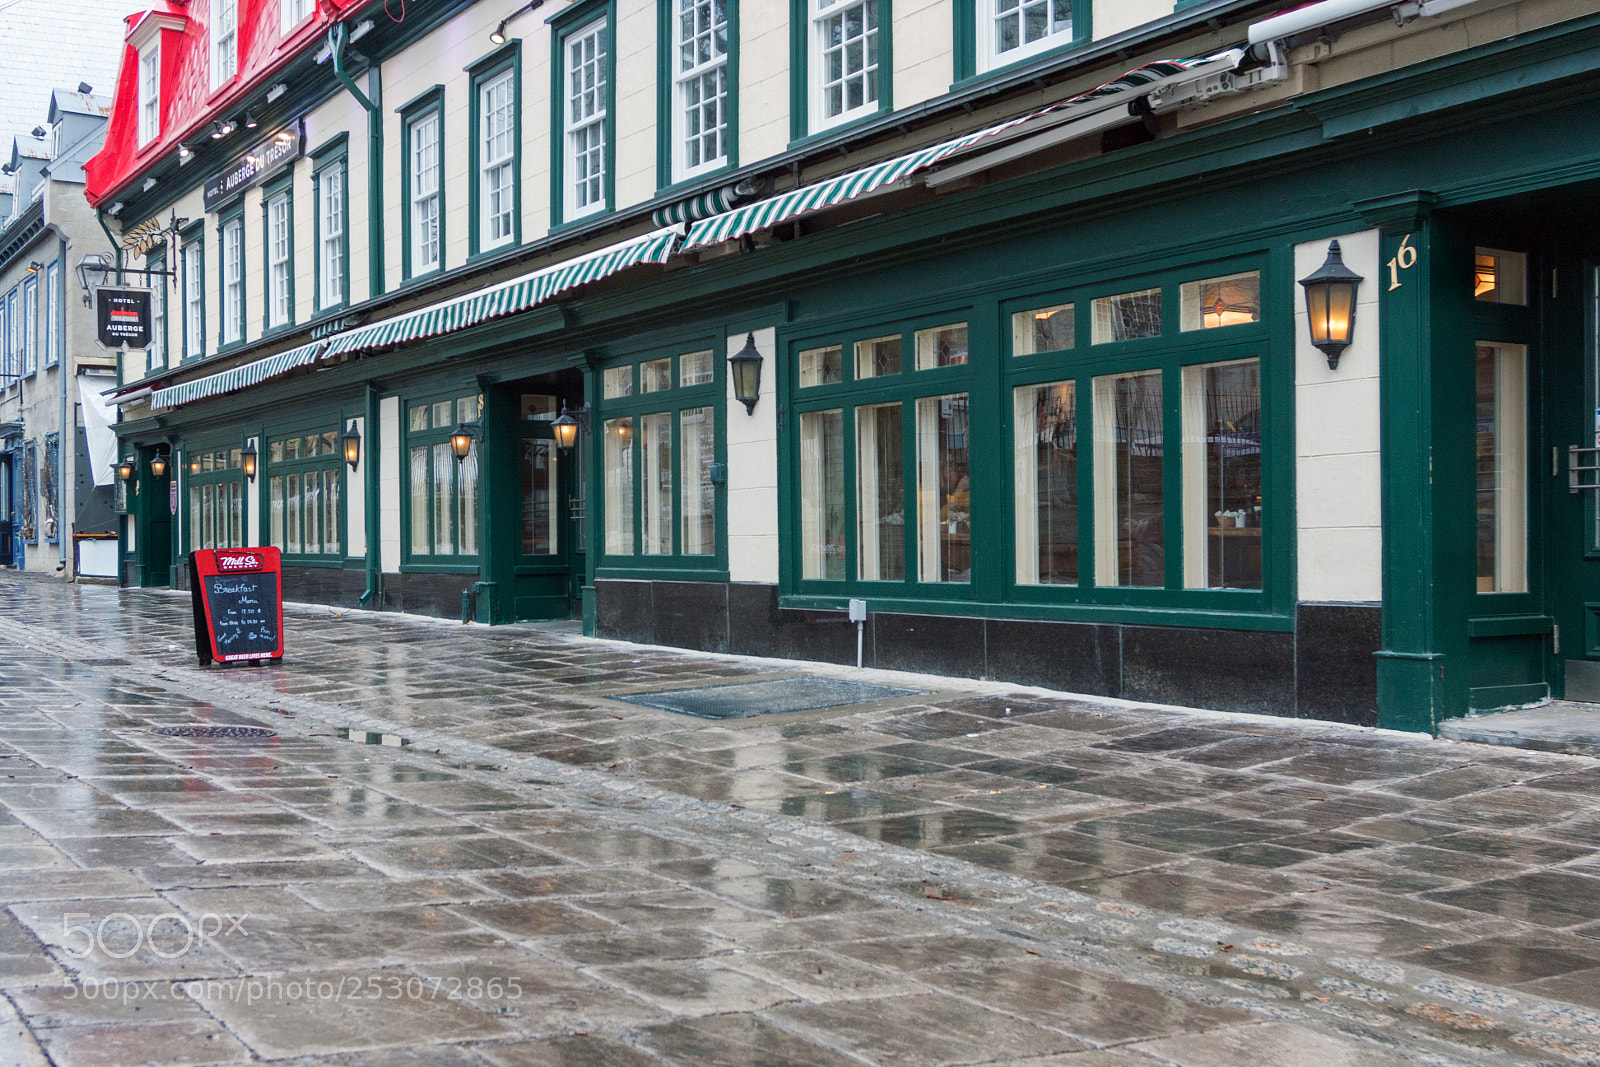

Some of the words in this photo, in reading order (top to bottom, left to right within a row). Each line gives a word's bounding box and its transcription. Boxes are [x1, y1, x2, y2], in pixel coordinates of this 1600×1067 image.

[226, 163, 255, 190] AUBERGE
[255, 154, 265, 171] DU
[1386, 234, 1418, 292] 16
[106, 324, 144, 332] AUBERGE
[220, 556, 244, 566] Mill
[213, 583, 259, 594] Breakfast
[238, 595, 260, 604] Menu
